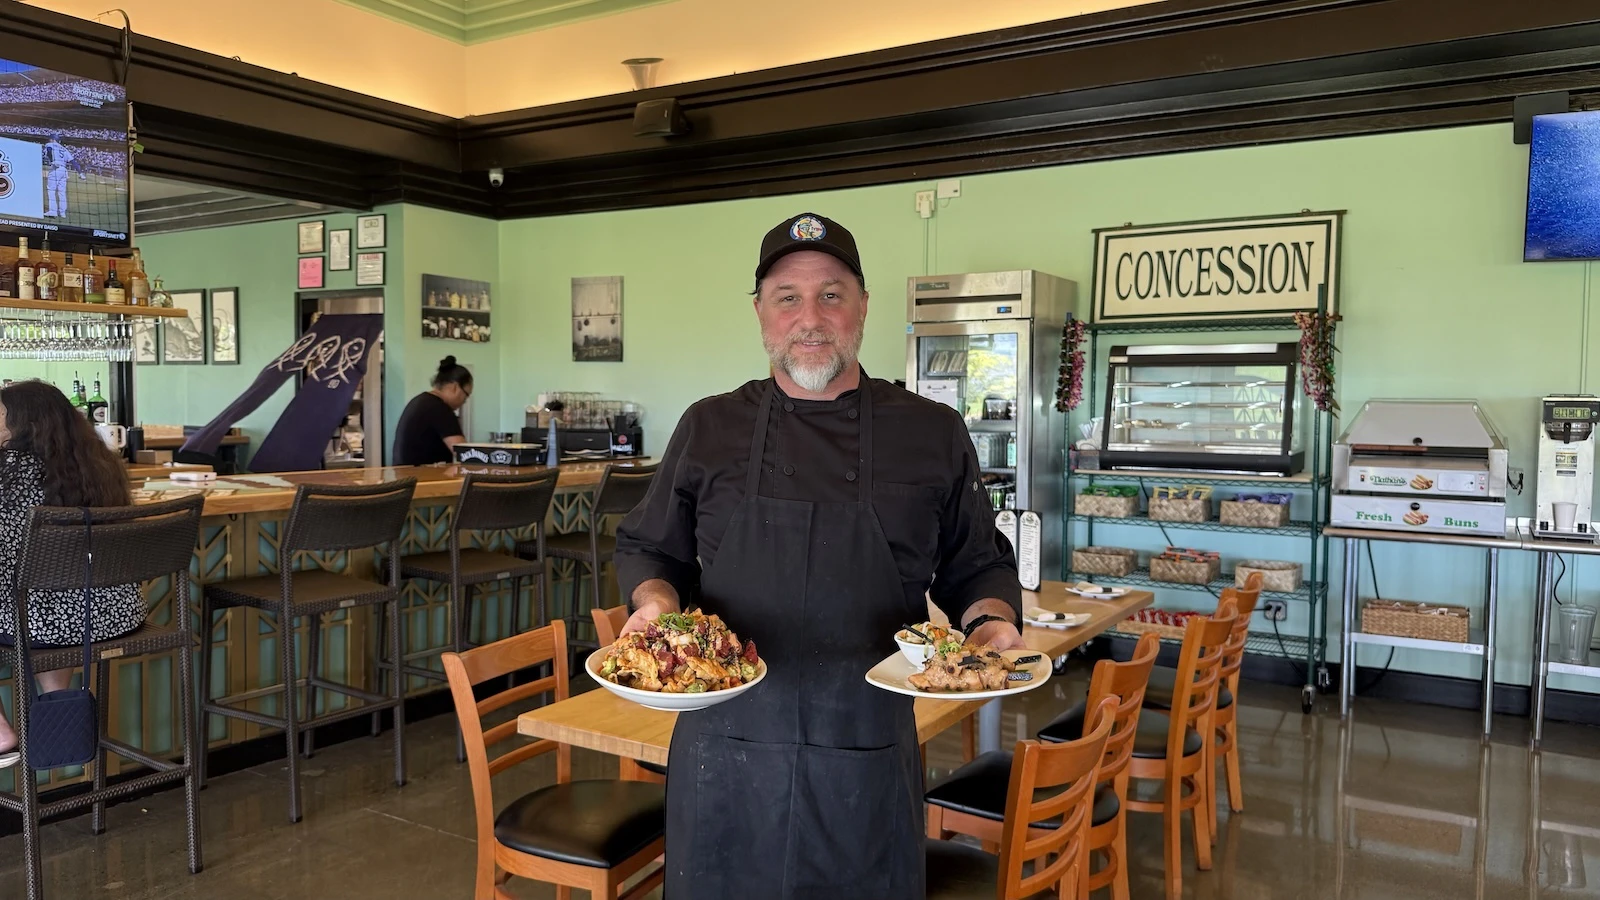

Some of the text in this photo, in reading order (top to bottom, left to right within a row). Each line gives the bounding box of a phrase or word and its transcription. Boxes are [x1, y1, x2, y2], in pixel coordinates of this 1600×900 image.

[9, 220, 37, 229] PRESENTED
[1116, 241, 1314, 301] CONCESSION
[1355, 511, 1479, 528] Fresh Buns
